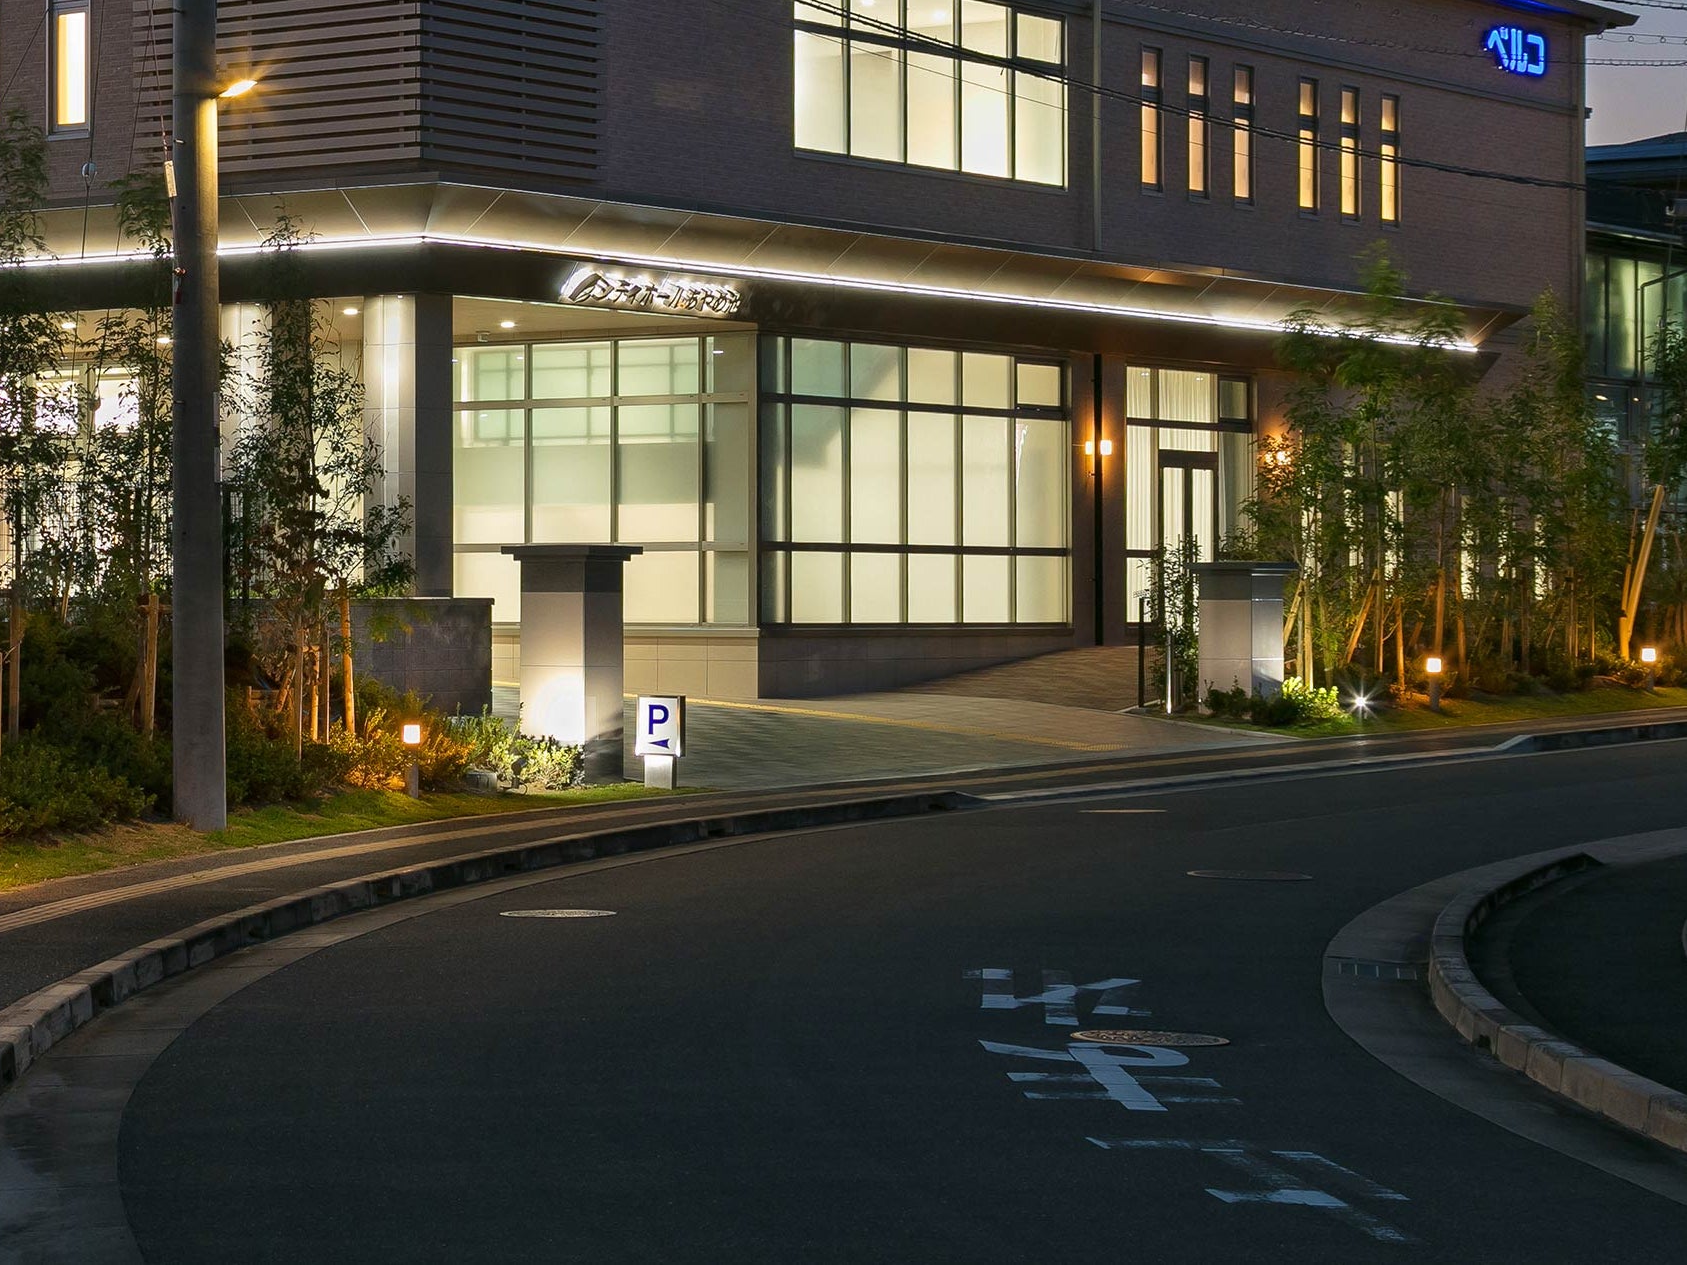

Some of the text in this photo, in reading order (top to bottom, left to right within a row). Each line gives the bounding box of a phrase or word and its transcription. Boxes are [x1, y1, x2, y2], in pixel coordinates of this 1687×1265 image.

[1488, 26, 1545, 75] ベルコ
[648, 704, 669, 735] P
